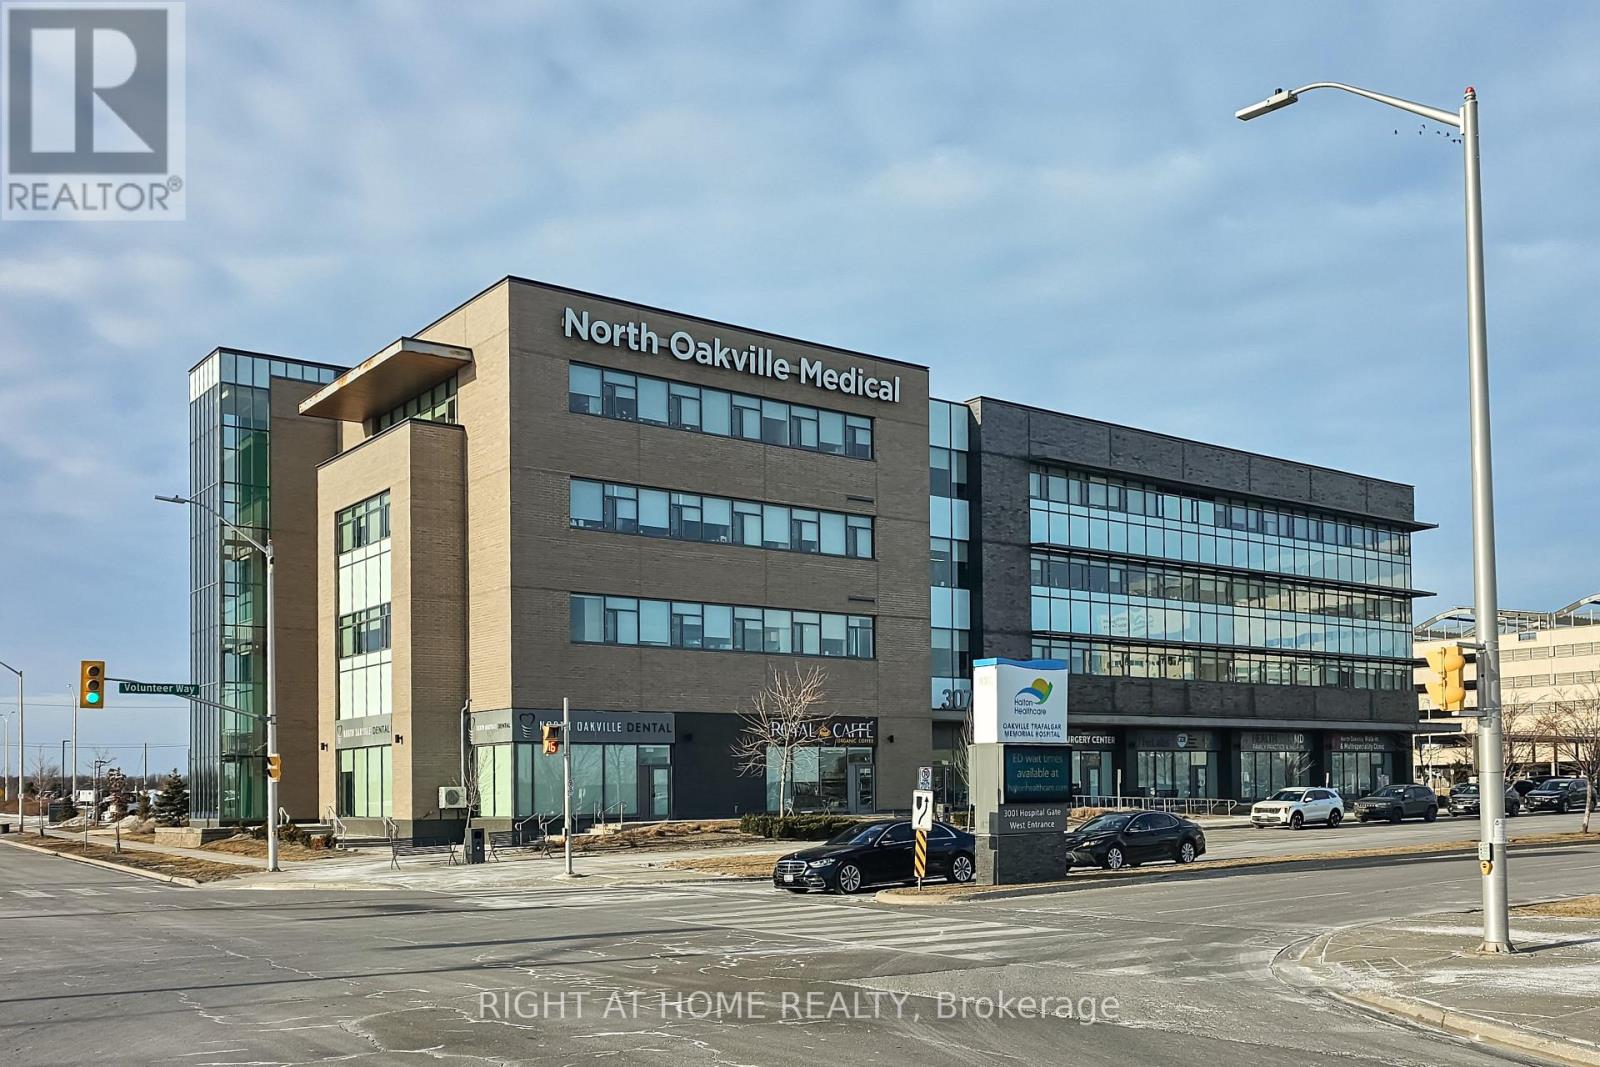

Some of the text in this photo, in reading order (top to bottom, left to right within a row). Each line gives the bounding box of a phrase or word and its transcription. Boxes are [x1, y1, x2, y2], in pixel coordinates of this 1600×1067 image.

[562, 307, 902, 403] North Oakville Medical
[124, 682, 195, 695] Volunteer Way
[1014, 698, 1033, 707] Halton
[1014, 707, 1047, 716] Healthcare
[576, 721, 622, 732] OAKVILLE
[626, 722, 673, 734] DENTAL
[1002, 722, 1062, 731] OAKVILLE TRAFALGAR
[1004, 730, 1034, 738] MEMORIAL
[1091, 735, 1116, 744] CENTER
[1012, 753, 1024, 764] ED
[1025, 754, 1042, 764] wait
[1016, 767, 1060, 778] available at
[1003, 808, 1062, 818] 3001 Hospital Gate
[1009, 820, 1055, 830] West Entrance
